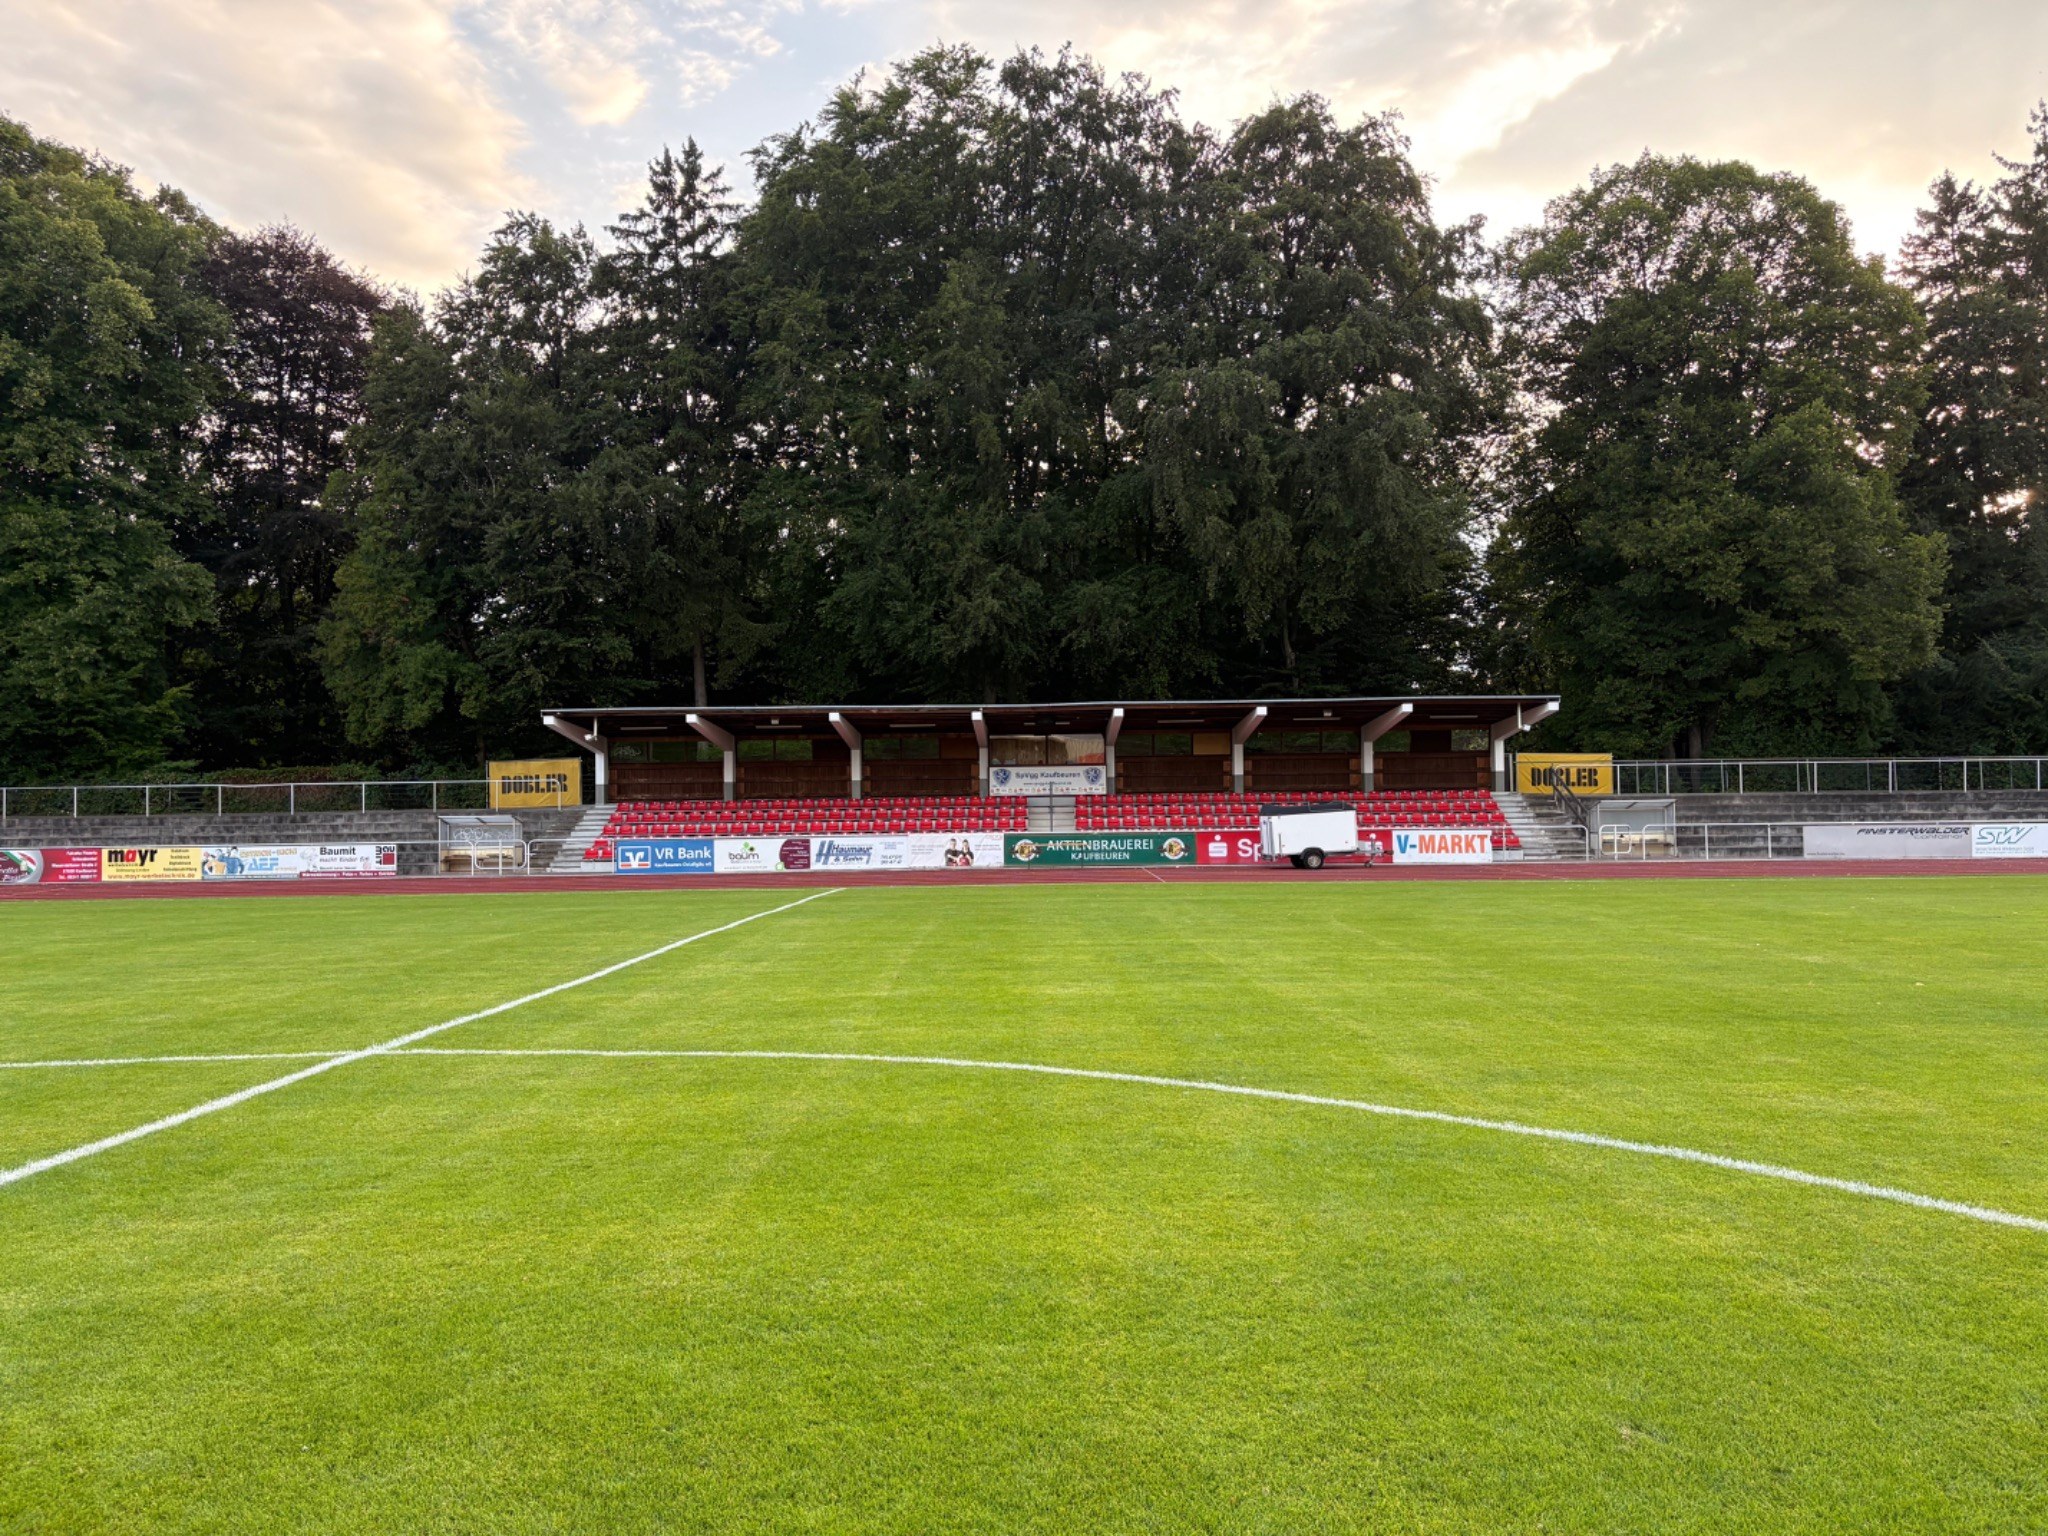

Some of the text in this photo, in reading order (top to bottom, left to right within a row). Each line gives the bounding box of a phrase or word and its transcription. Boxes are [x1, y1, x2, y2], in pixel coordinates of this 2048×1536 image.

[501, 773, 569, 795] DOBLER
[1047, 838, 1154, 851] AKTIENBRAUEREI
[1396, 834, 1488, 854] V-MARKT
[1976, 826, 2033, 845] STW
[107, 848, 158, 867] mayr
[319, 845, 357, 856] Baumit
[655, 845, 712, 860] VR Bank
[1070, 851, 1131, 860] KAUFBEUREN
[1237, 838, 1263, 863] Sp
